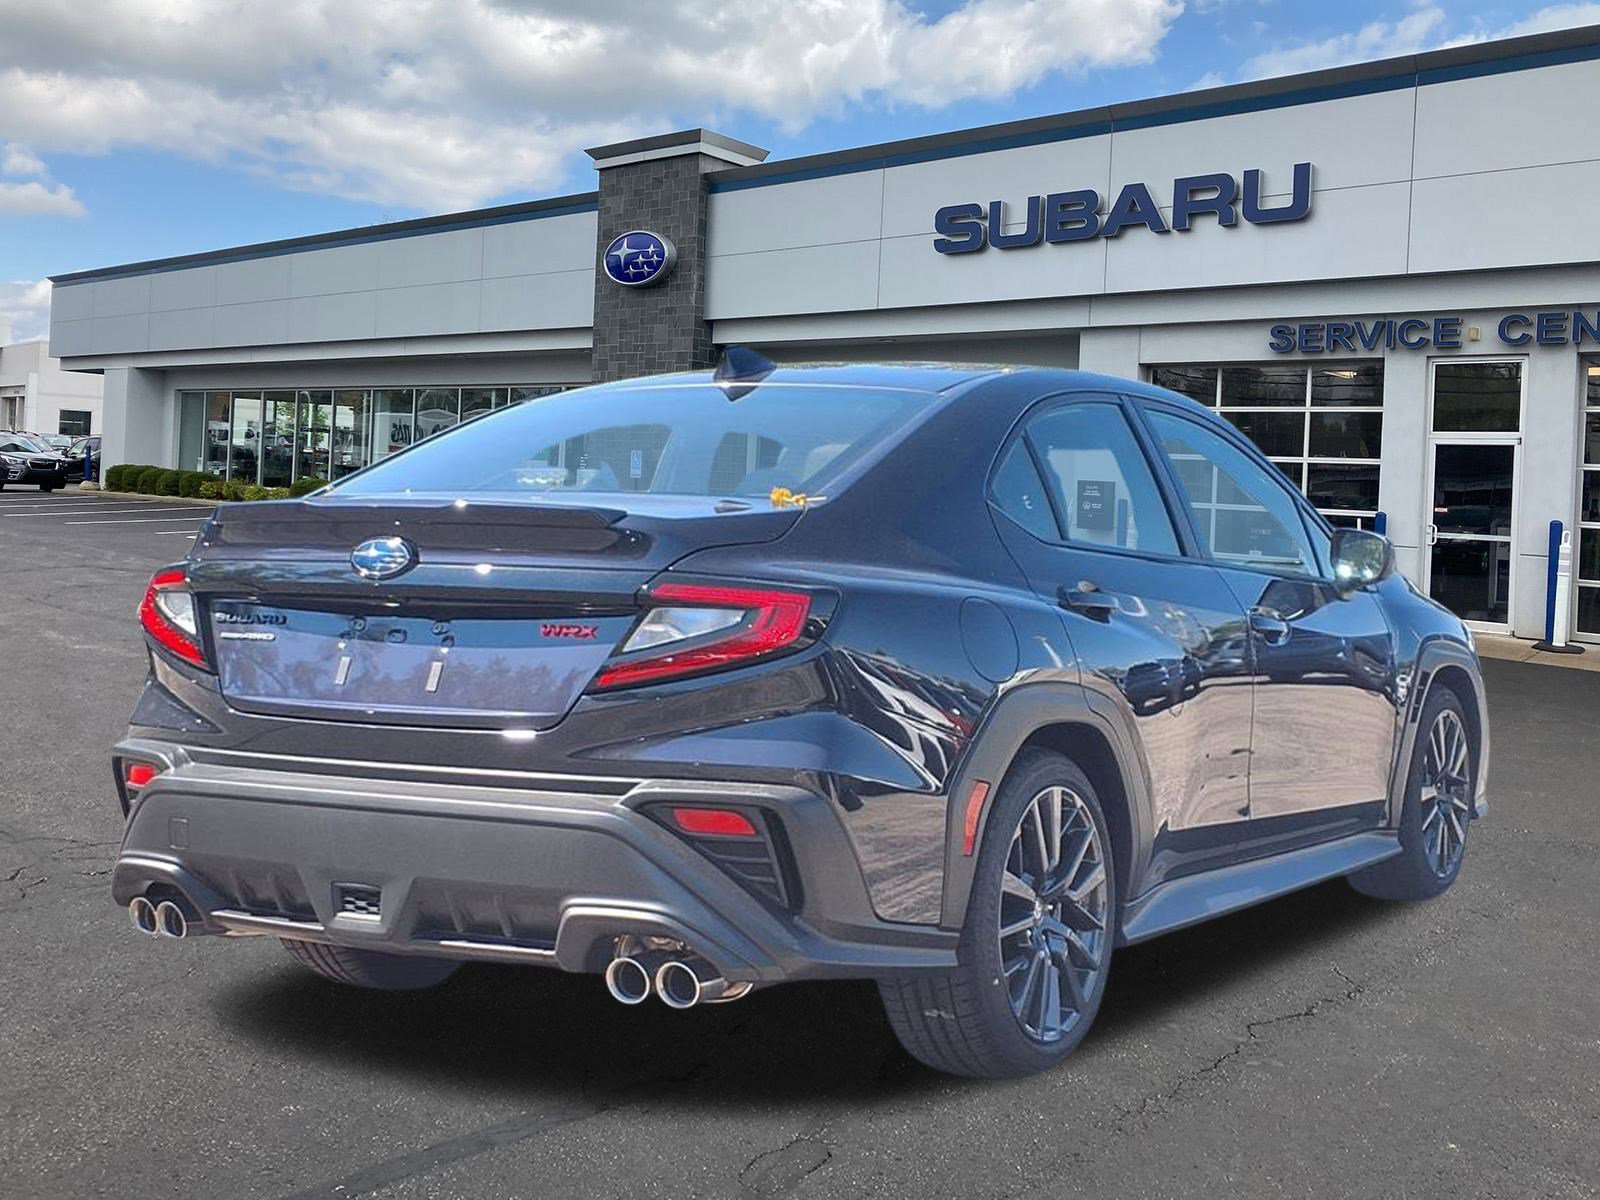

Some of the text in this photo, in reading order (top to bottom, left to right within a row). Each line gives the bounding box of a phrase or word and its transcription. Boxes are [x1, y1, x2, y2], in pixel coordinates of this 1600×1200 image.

[933, 161, 1313, 255] SUBARU
[1268, 311, 1600, 353] SERVICE CEN
[214, 610, 288, 625] SUBARU
[540, 623, 600, 640] WRX
